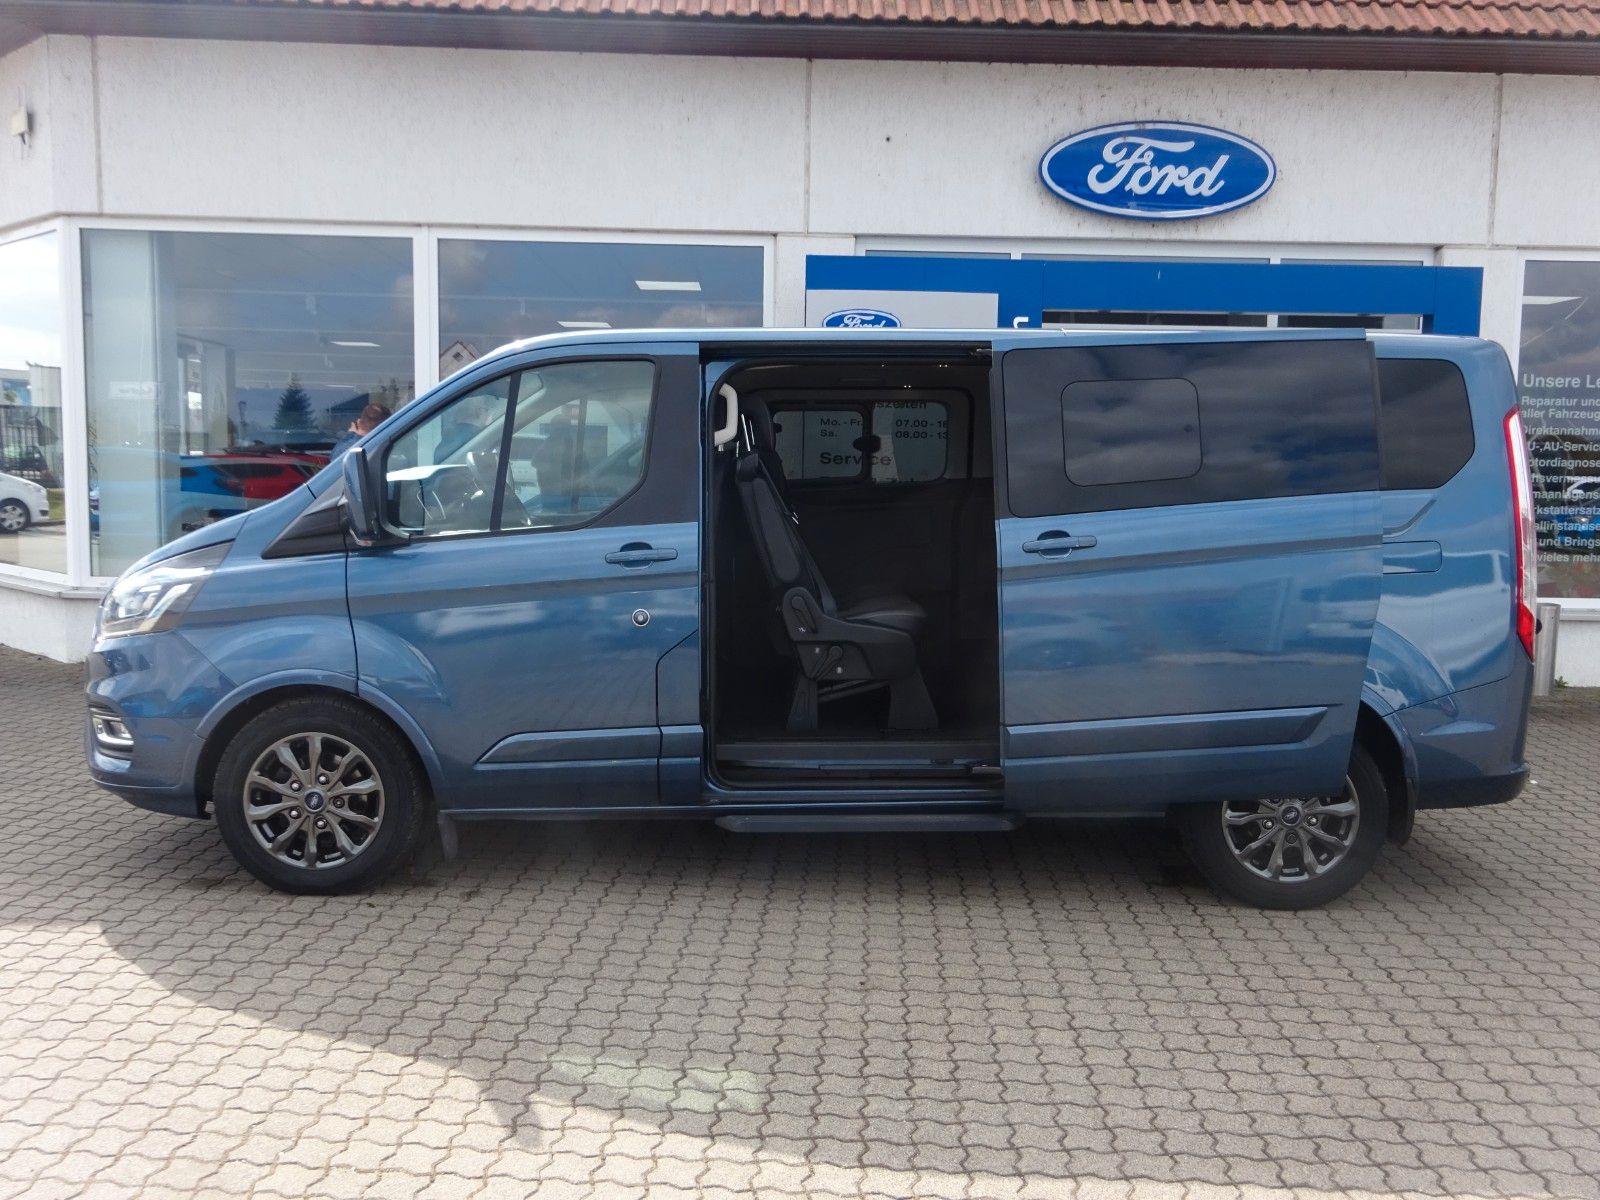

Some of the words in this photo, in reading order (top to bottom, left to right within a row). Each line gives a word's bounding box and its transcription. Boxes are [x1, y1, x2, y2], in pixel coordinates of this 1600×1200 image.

[1087, 136, 1230, 196] Ford
[1523, 373, 1581, 388] Unsere
[1521, 395, 1578, 408] Reparatur
[1520, 408, 1546, 419] aller
[1548, 408, 1600, 422] Fahrzeug
[820, 418, 841, 426] Mo.
[820, 429, 838, 437] Sa.
[895, 430, 928, 439] 08.00
[1524, 425, 1600, 437] irektannahm
[819, 451, 893, 466] Servce
[1538, 536, 1561, 547] und
[1536, 552, 1569, 562] vieles
